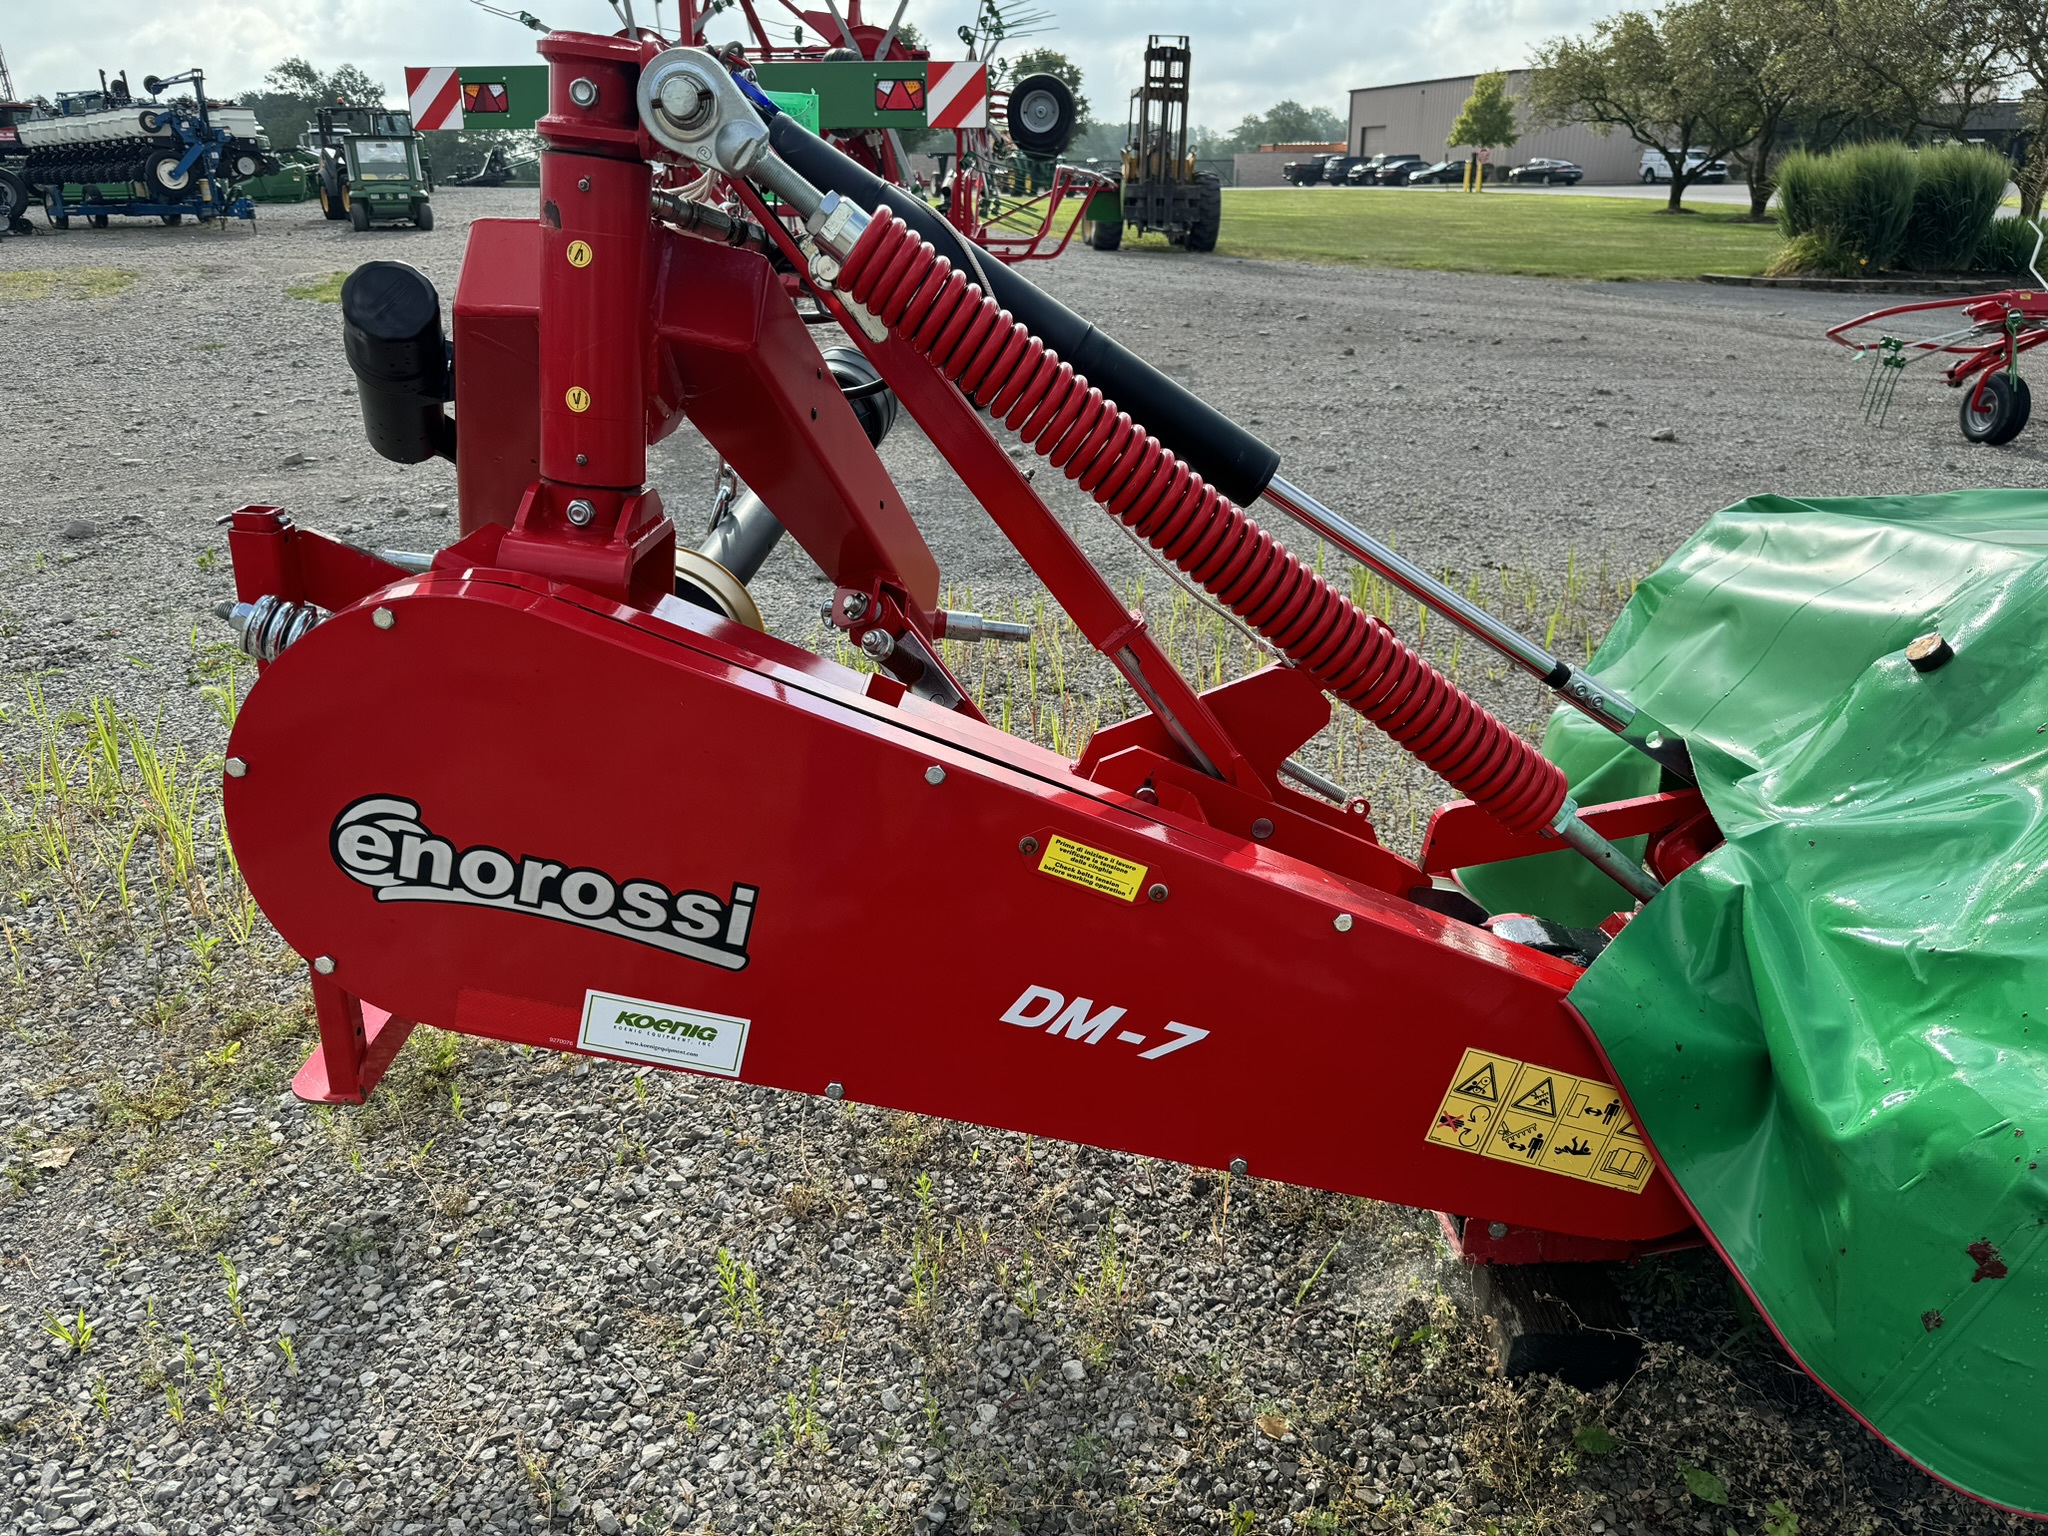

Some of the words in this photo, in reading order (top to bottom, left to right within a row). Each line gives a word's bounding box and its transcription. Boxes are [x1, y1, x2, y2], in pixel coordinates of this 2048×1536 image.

[1055, 839, 1075, 850] Prima
[1084, 848, 1109, 862] iniziare
[1059, 847, 1091, 862] verificare
[1100, 861, 1129, 875] tensione
[336, 813, 757, 952] enorossi
[1043, 864, 1065, 876] before
[1066, 872, 1094, 886] working
[1094, 882, 1126, 897] operation
[1055, 861, 1076, 873] Check
[1077, 869, 1094, 880] belts
[1095, 876, 1120, 889] tension
[1088, 862, 1113, 876] cinghie
[998, 984, 1211, 1060] DM-7
[613, 1024, 643, 1035] KOENIG
[697, 1041, 716, 1049] INC.
[624, 1039, 699, 1058] www.koenigequipment.com
